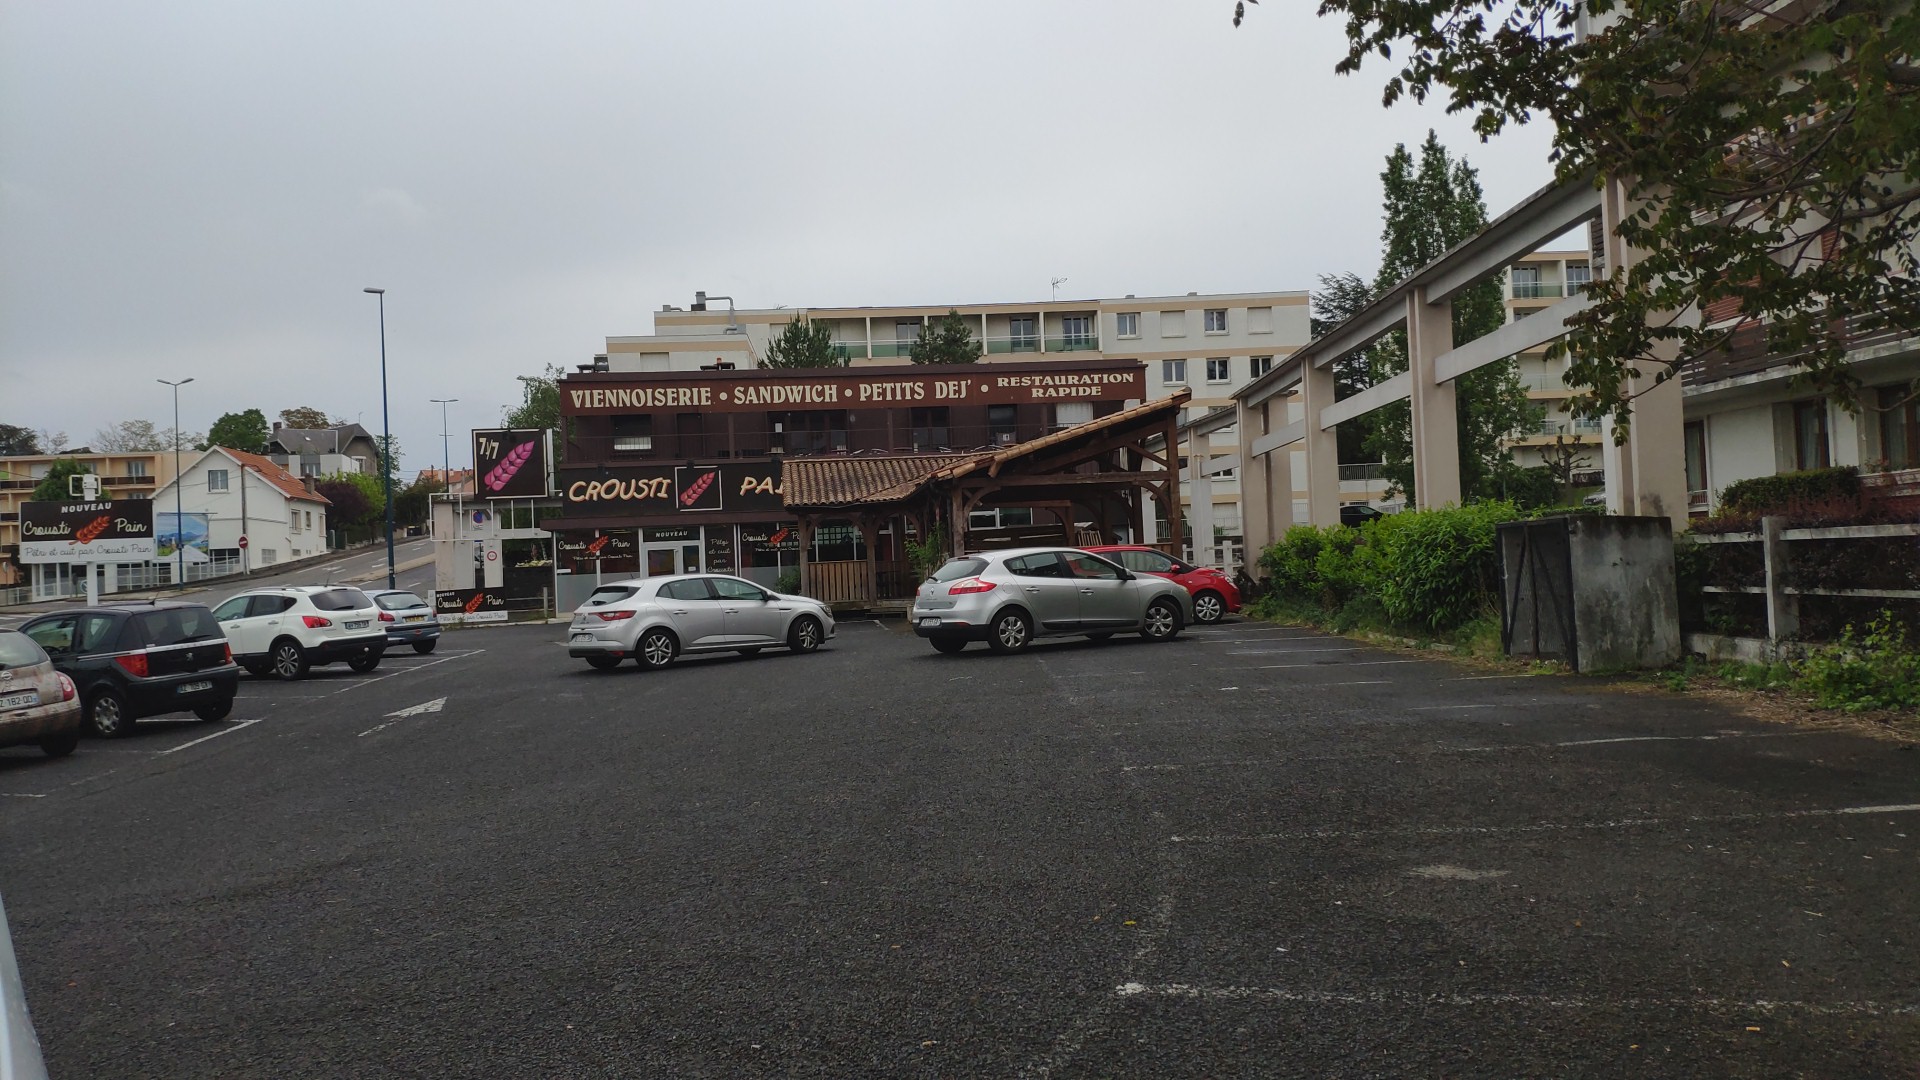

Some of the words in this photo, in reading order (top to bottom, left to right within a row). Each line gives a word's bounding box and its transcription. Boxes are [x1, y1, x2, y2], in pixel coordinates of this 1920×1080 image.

[997, 373, 1134, 387] RESTAURATION
[570, 387, 711, 408] VIENNOISERIE
[733, 384, 838, 405] SANDWICH
[859, 381, 925, 401] PETITS
[1031, 386, 1102, 398] RAPIDE
[568, 477, 672, 502] CROUSTI
[61, 502, 112, 514] NOUVEAU
[23, 521, 71, 536] Crousti
[114, 517, 147, 533] Pain
